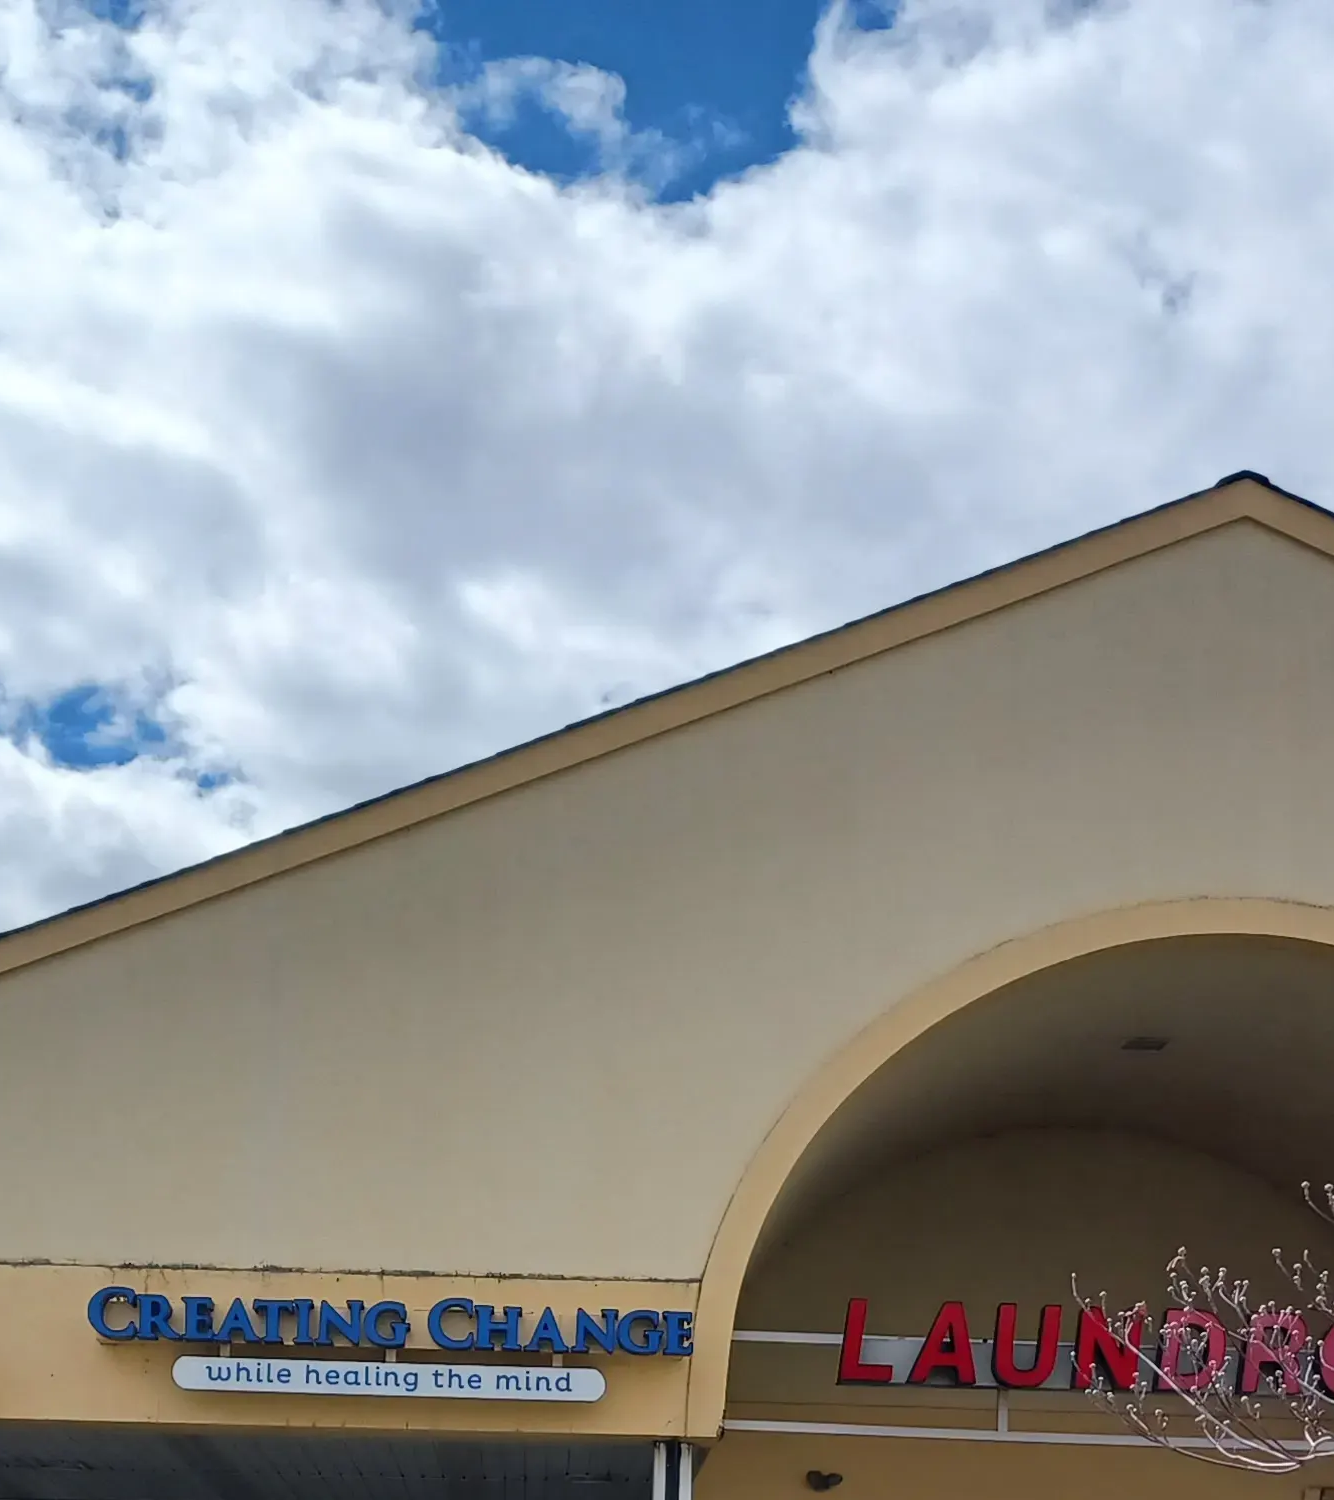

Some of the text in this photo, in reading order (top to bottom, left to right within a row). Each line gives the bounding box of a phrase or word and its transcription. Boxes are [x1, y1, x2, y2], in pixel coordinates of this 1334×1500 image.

[87, 1286, 694, 1356] CREATING CHANGE
[205, 1361, 572, 1393] while healing the mind
